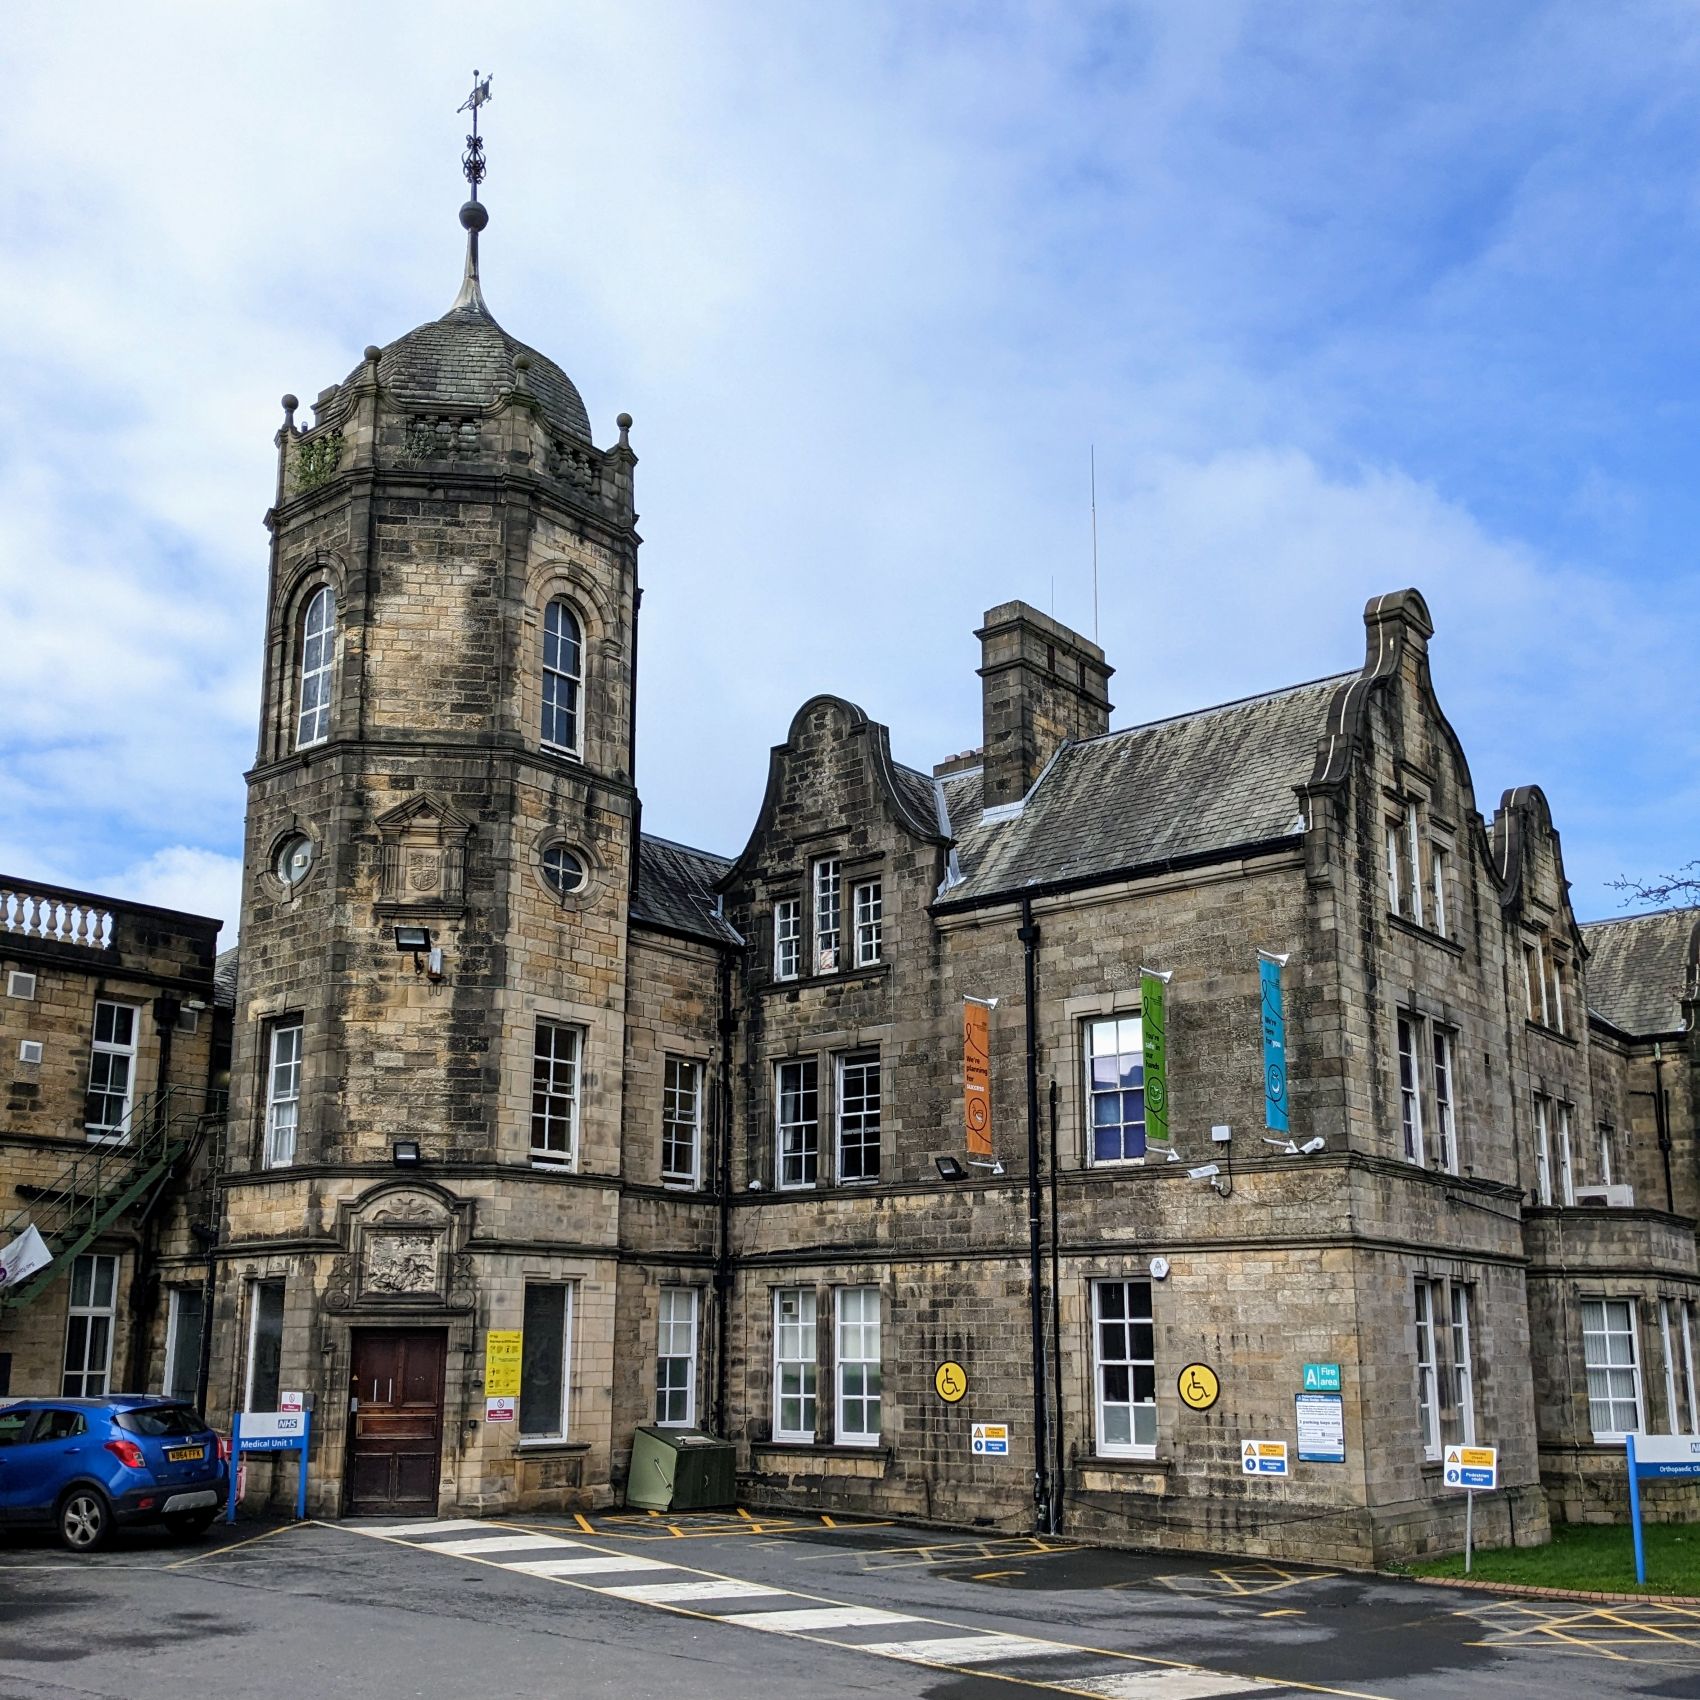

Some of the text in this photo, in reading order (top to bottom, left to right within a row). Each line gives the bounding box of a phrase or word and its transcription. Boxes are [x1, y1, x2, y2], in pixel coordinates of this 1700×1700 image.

[966, 1056, 980, 1064] We're
[966, 1065, 988, 1077] planning
[1306, 1367, 1336, 1386] A Fire
[278, 1419, 297, 1428] NHS
[241, 1440, 270, 1448] Medical
[1660, 1465, 1691, 1474] Orthopaedic
